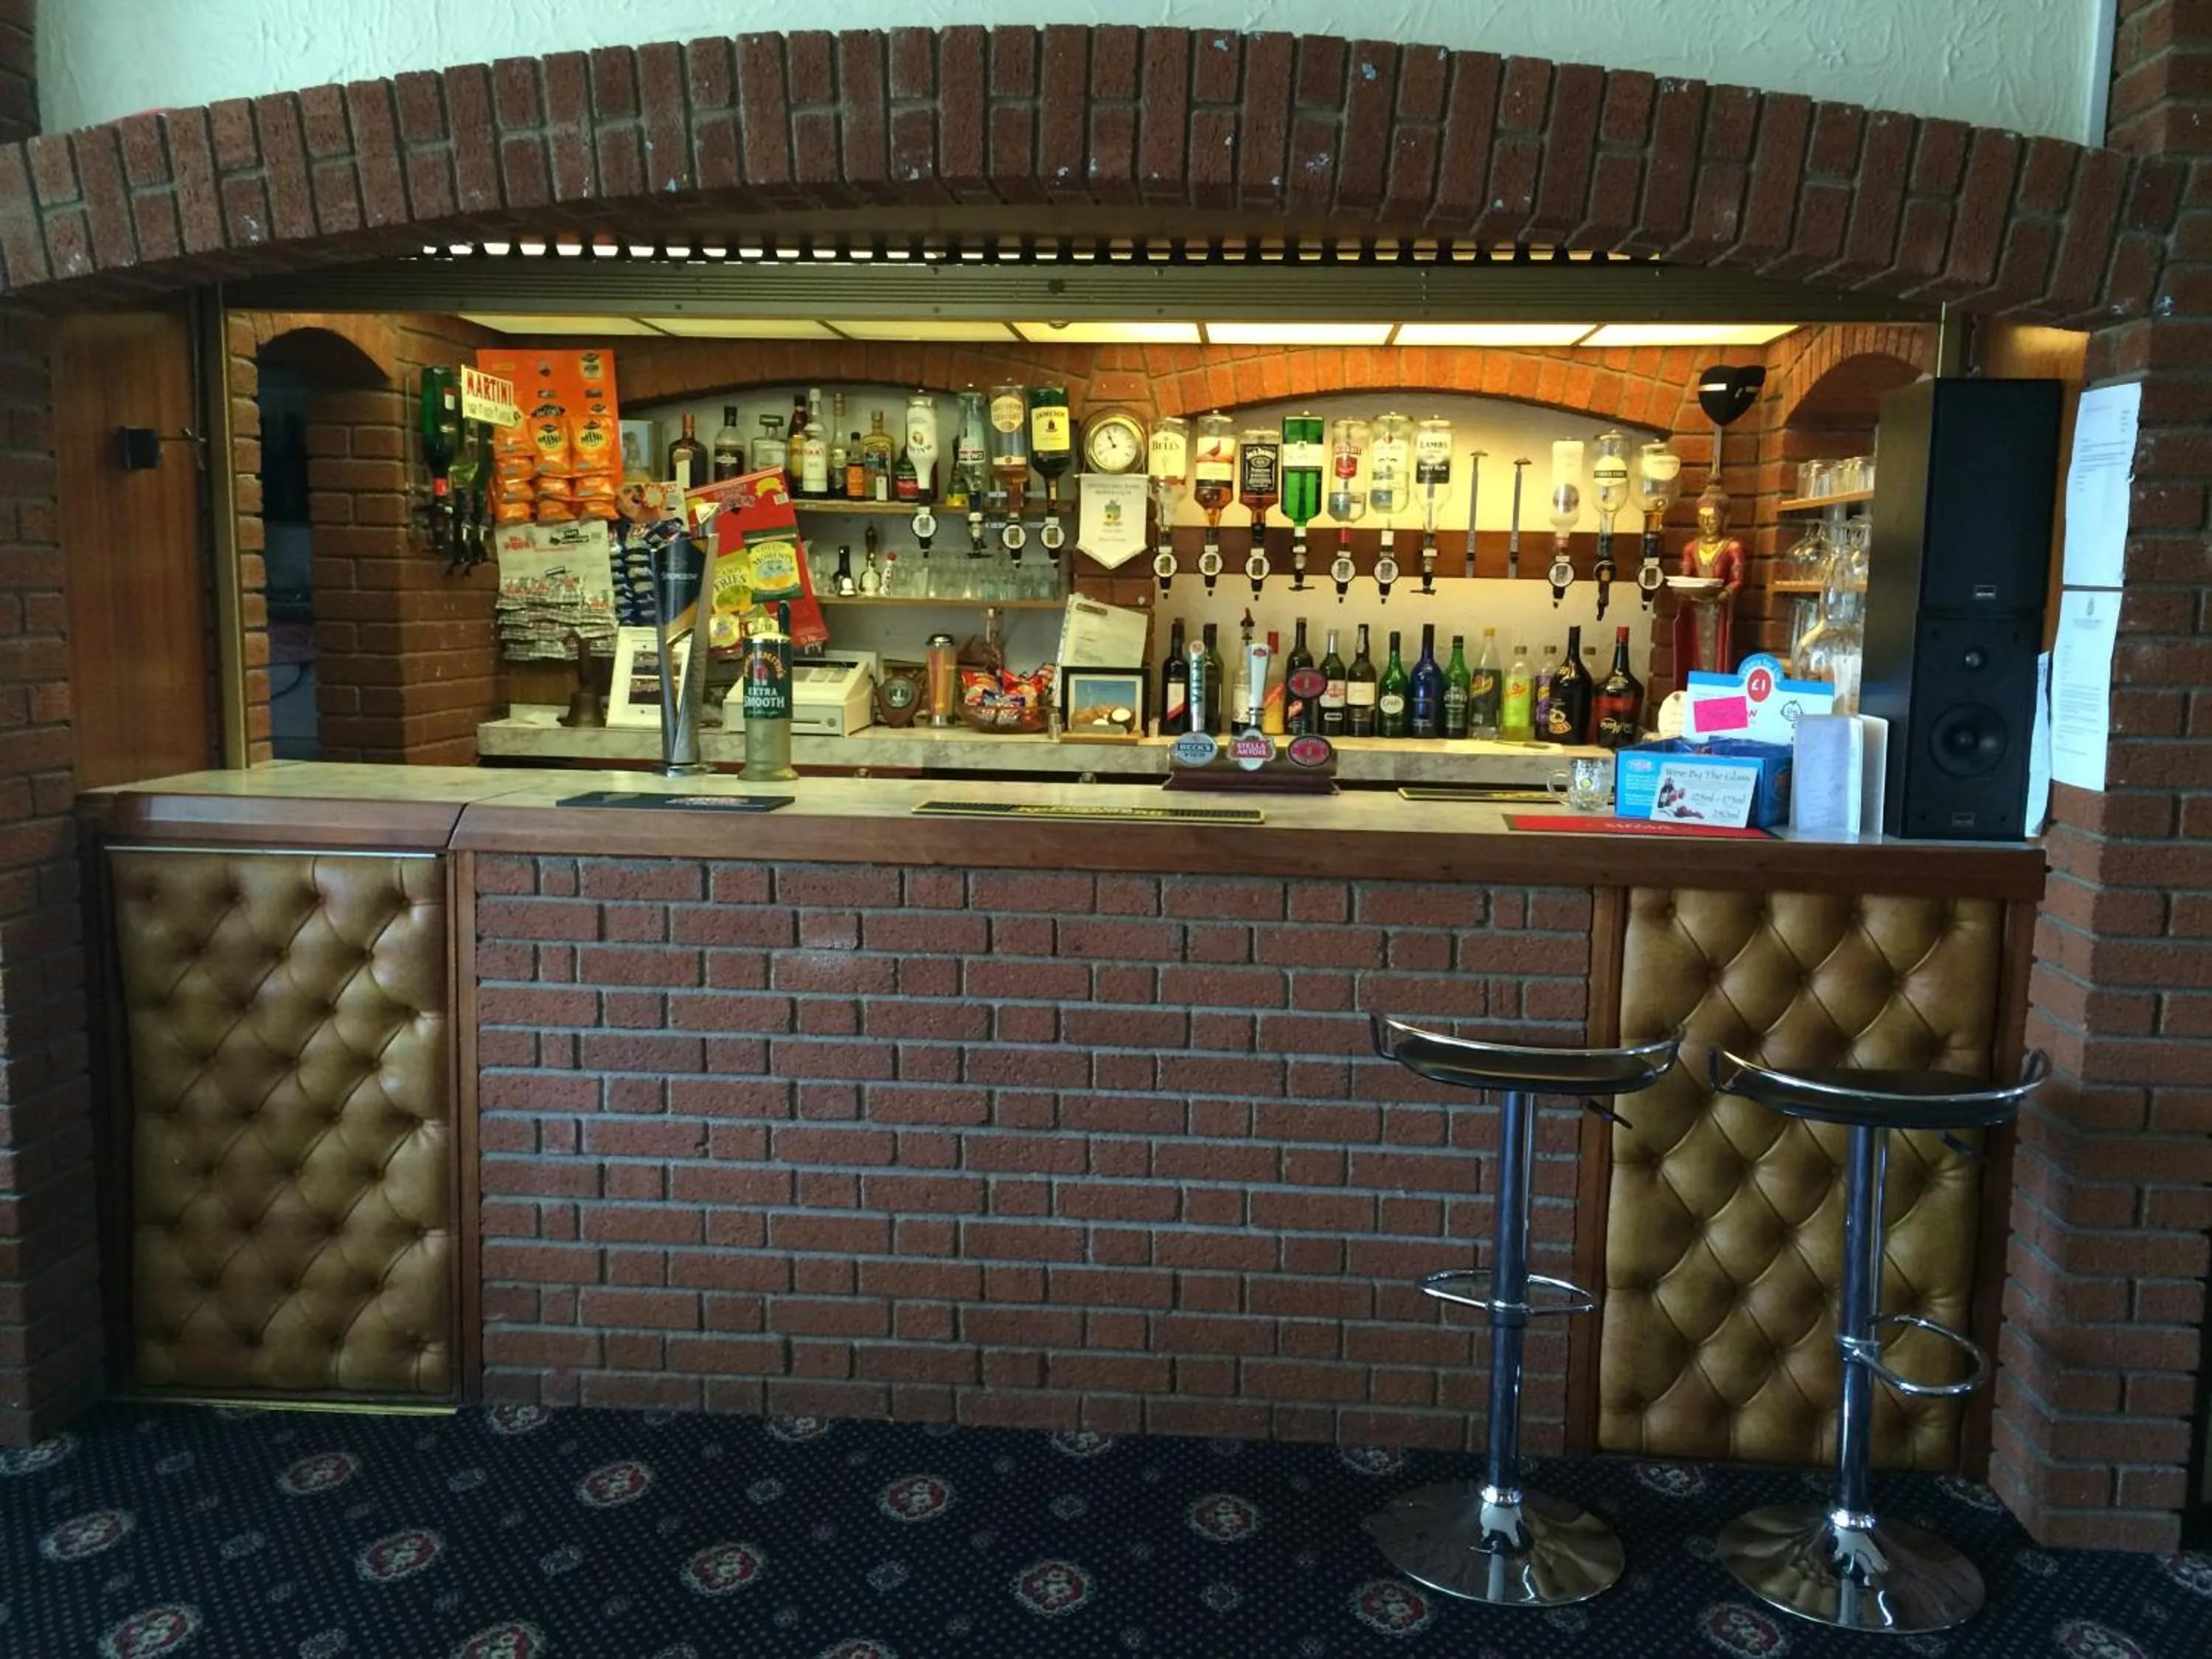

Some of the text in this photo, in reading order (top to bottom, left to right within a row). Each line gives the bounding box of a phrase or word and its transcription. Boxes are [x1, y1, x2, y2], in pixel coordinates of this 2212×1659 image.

[467, 370, 515, 405] MARTINI
[1035, 411, 1065, 420] JAMESON
[1750, 678, 1766, 691] £1
[748, 687, 778, 697] EXTRA
[744, 696, 786, 708] SMOOTH
[1688, 769, 1703, 779] By
[1705, 771, 1723, 779] The
[1725, 771, 1750, 782] Glass
